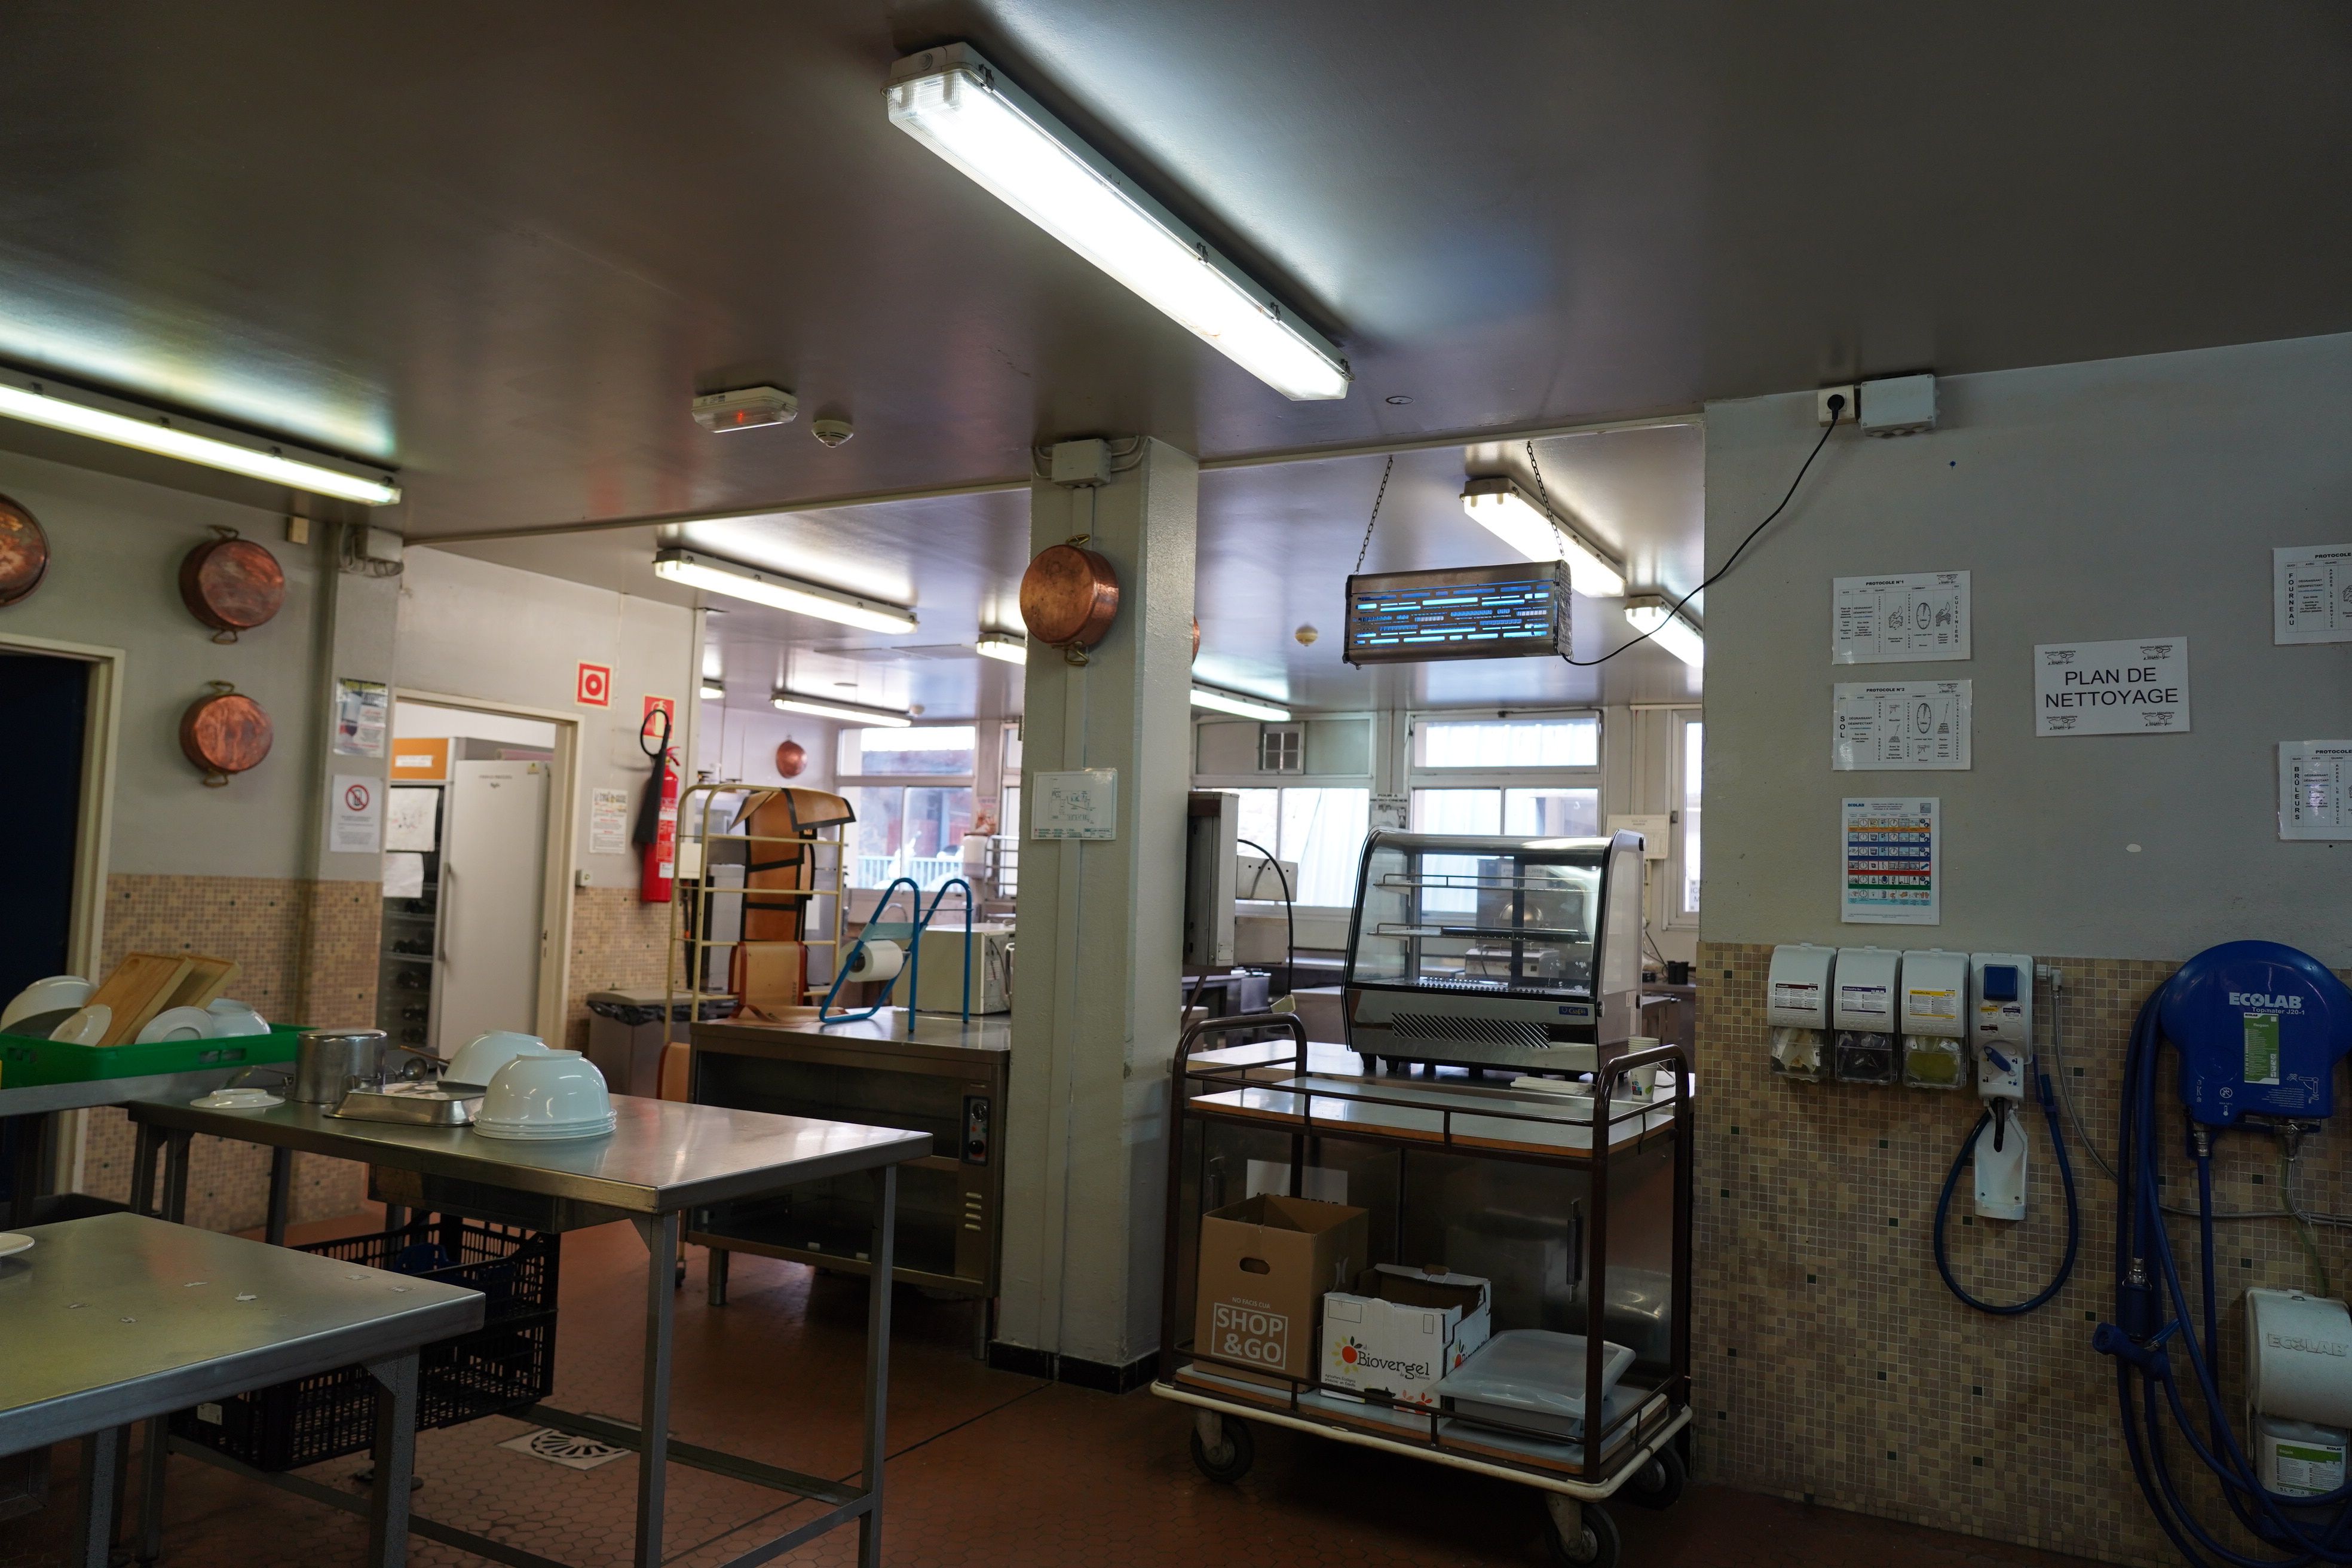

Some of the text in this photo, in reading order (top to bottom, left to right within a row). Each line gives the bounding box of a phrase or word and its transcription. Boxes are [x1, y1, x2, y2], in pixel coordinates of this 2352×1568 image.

[2065, 667, 2156, 685] PLAN DE
[2046, 688, 2178, 708] NETTOYAGE
[2229, 992, 2302, 1009] ECOLAB
[1217, 1307, 1284, 1337] SHOP
[1224, 1333, 1281, 1363] &GO
[2268, 1333, 2347, 1356] ECOLAB
[1358, 1350, 1429, 1380] Biovergel
